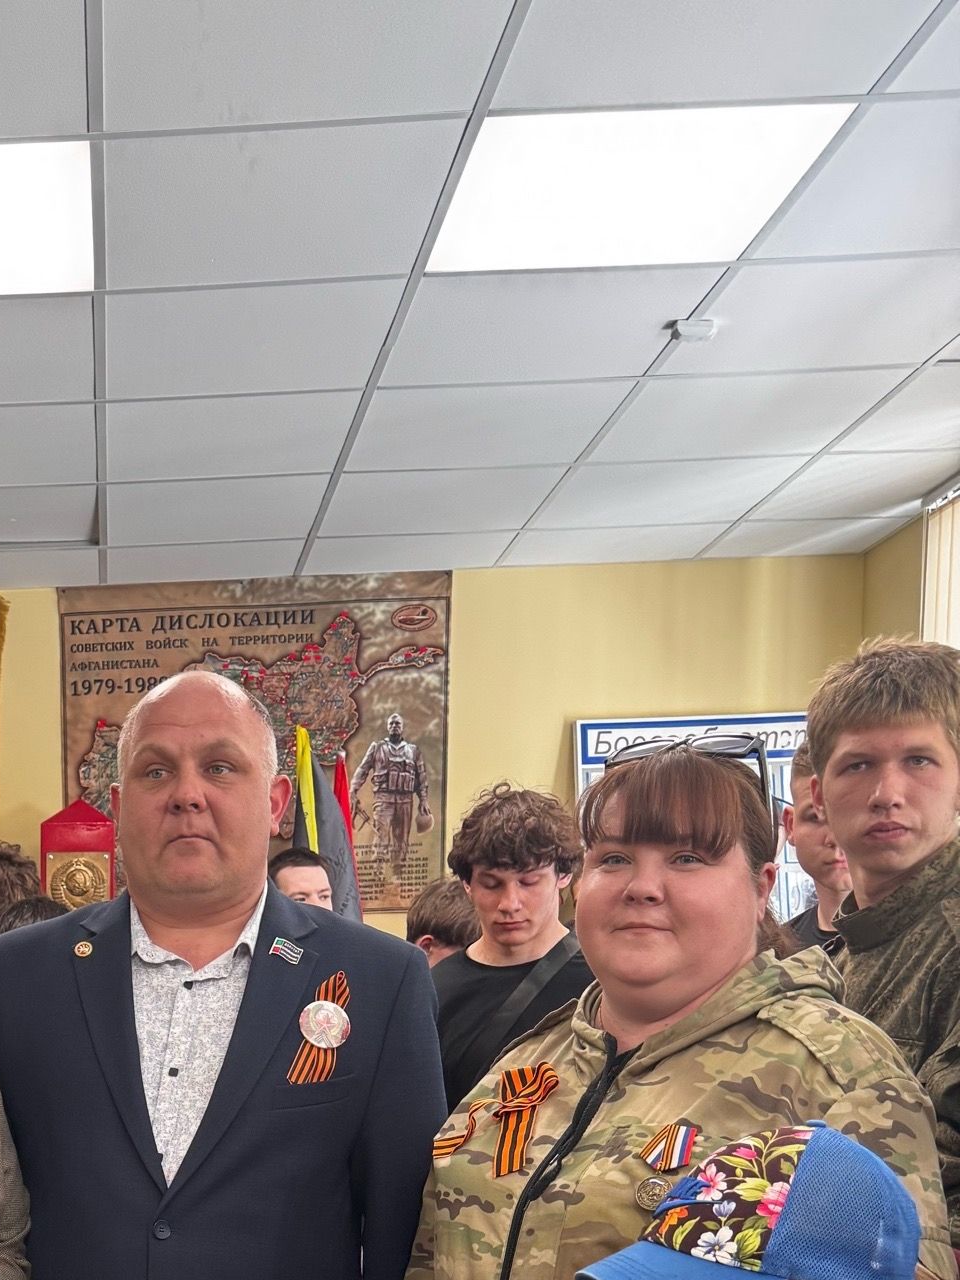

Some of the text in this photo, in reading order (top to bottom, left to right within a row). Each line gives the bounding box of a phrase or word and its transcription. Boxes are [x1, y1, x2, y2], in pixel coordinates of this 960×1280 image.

[70, 609, 316, 635] КАРТА ДИСЛОКАЦИИ
[70, 633, 314, 653] СОВЕТСКИХ ВОЙСК НА ТЕРРИТОРИИ
[70, 659, 160, 672] АФГАНИСТАНА
